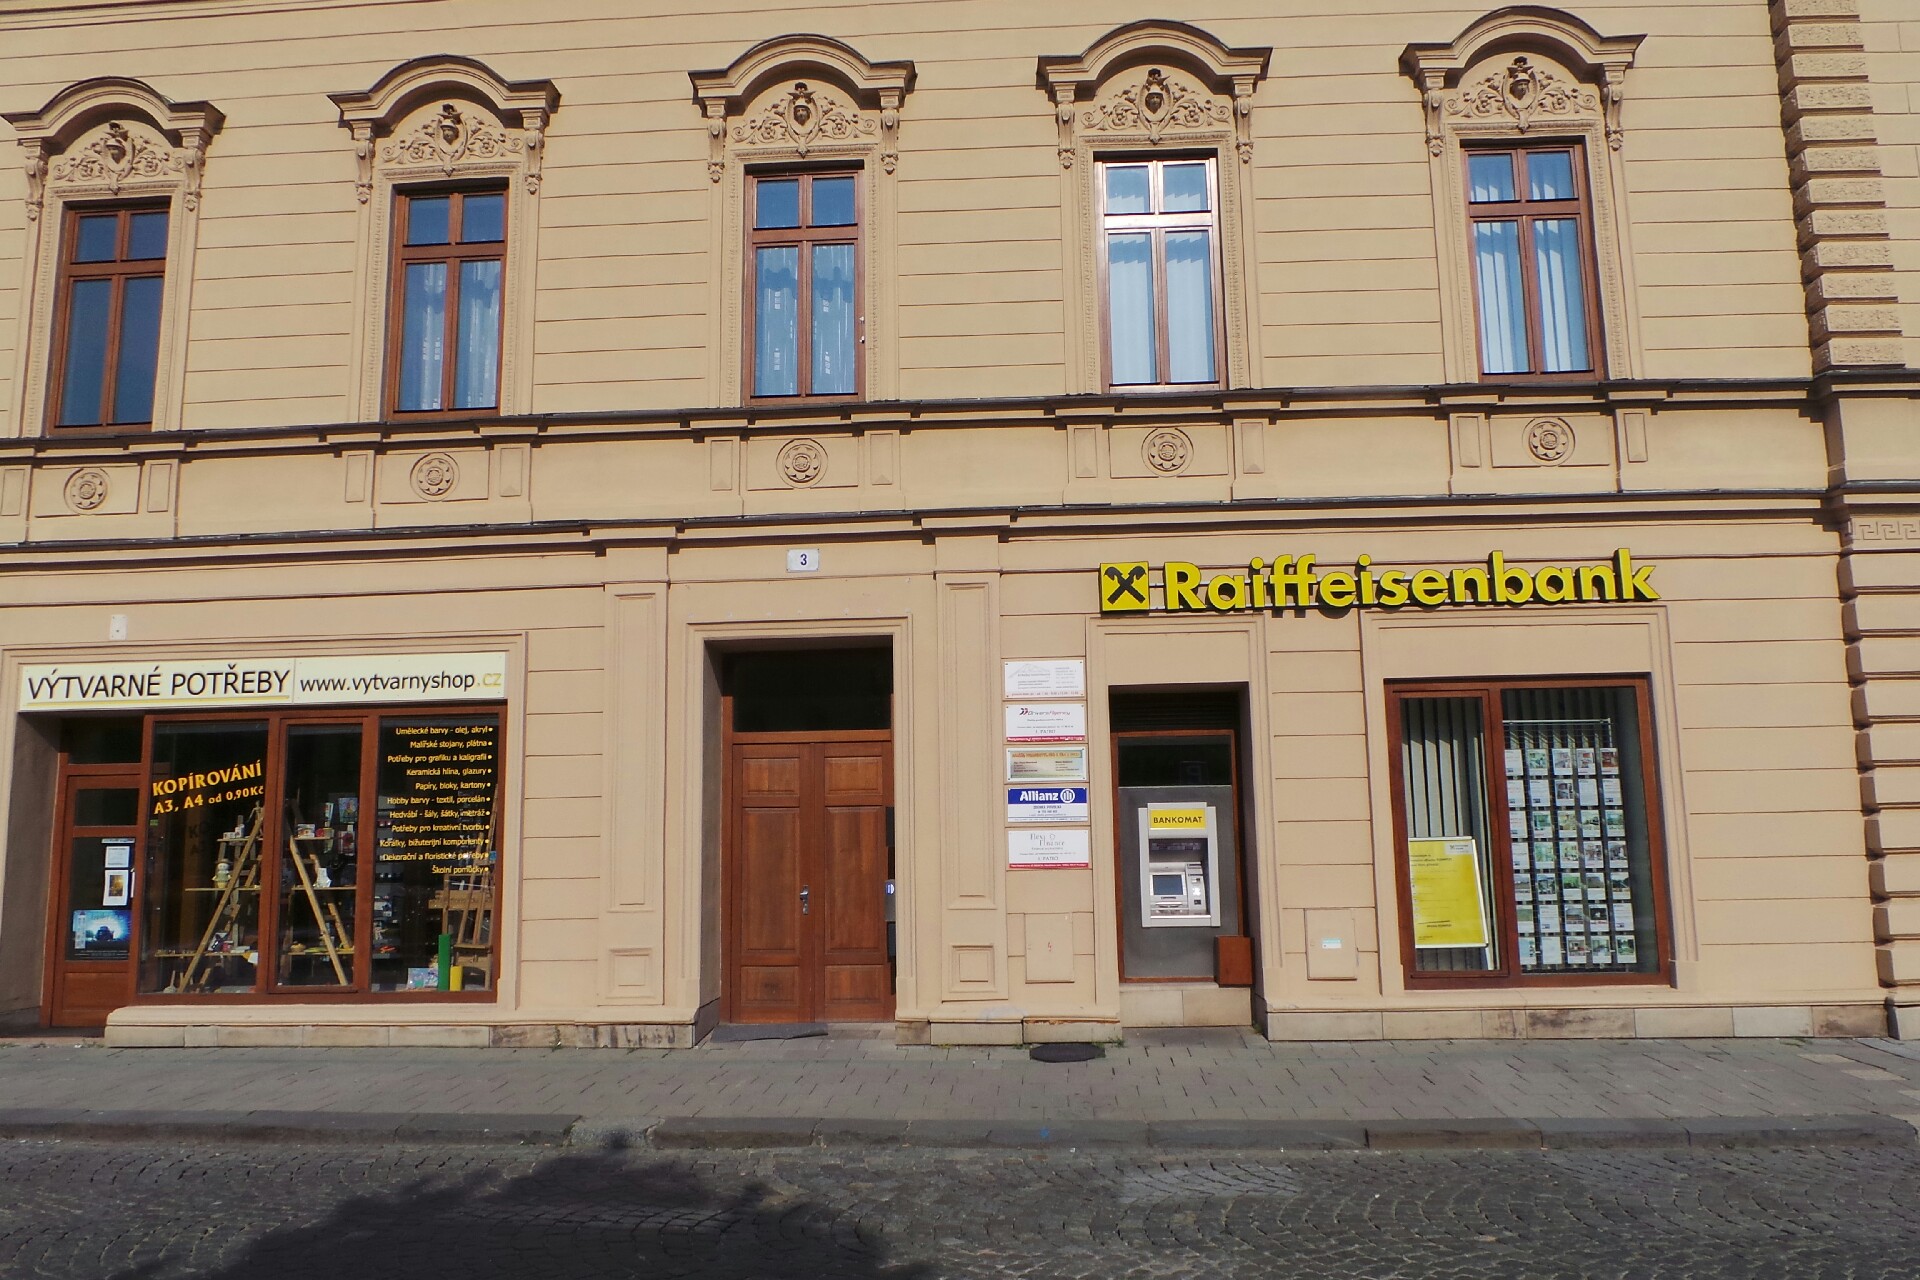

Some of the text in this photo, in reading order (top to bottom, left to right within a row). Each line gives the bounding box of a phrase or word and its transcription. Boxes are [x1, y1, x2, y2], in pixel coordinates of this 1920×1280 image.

[800, 553, 807, 566] 3
[1163, 548, 1661, 610] Raiffeisenbank
[27, 663, 291, 700] VÝTVARNÉ POTŘEBY
[300, 670, 503, 693] www.vytvarnyshop.cz
[396, 727, 428, 735] Umělecké
[430, 727, 448, 735] barvy
[471, 726, 488, 734] akryl
[410, 739, 487, 749] Malířské stojany, plátna
[387, 754, 413, 763] Potřeby
[428, 754, 451, 763] grafiku
[442, 768, 460, 776] hlína,
[462, 768, 487, 776] glazury
[152, 760, 262, 796] KOPÍROVÁNÍ
[415, 782, 486, 790] Papíry, bloky, kartony
[387, 797, 409, 805] Hobby
[410, 797, 430, 805] barvy
[436, 796, 455, 804] textil,
[456, 795, 485, 804] porcelán
[1020, 791, 1059, 801] Allianz
[154, 799, 179, 814] A3,
[184, 794, 203, 808] A4
[208, 794, 222, 804] od
[389, 810, 418, 818] Hedvábí
[424, 810, 439, 818] šály,
[441, 809, 459, 818] šátky,
[461, 809, 485, 817] metráž
[1153, 816, 1203, 824] BANKOMAT
[391, 825, 418, 833] Potřeby
[380, 837, 484, 847] Korálky, bižuterijní komponenty
[383, 852, 417, 860] Dekorační
[424, 852, 457, 860] floristické
[458, 851, 484, 860] potřeby
[432, 864, 484, 874] Školní pomůcky
